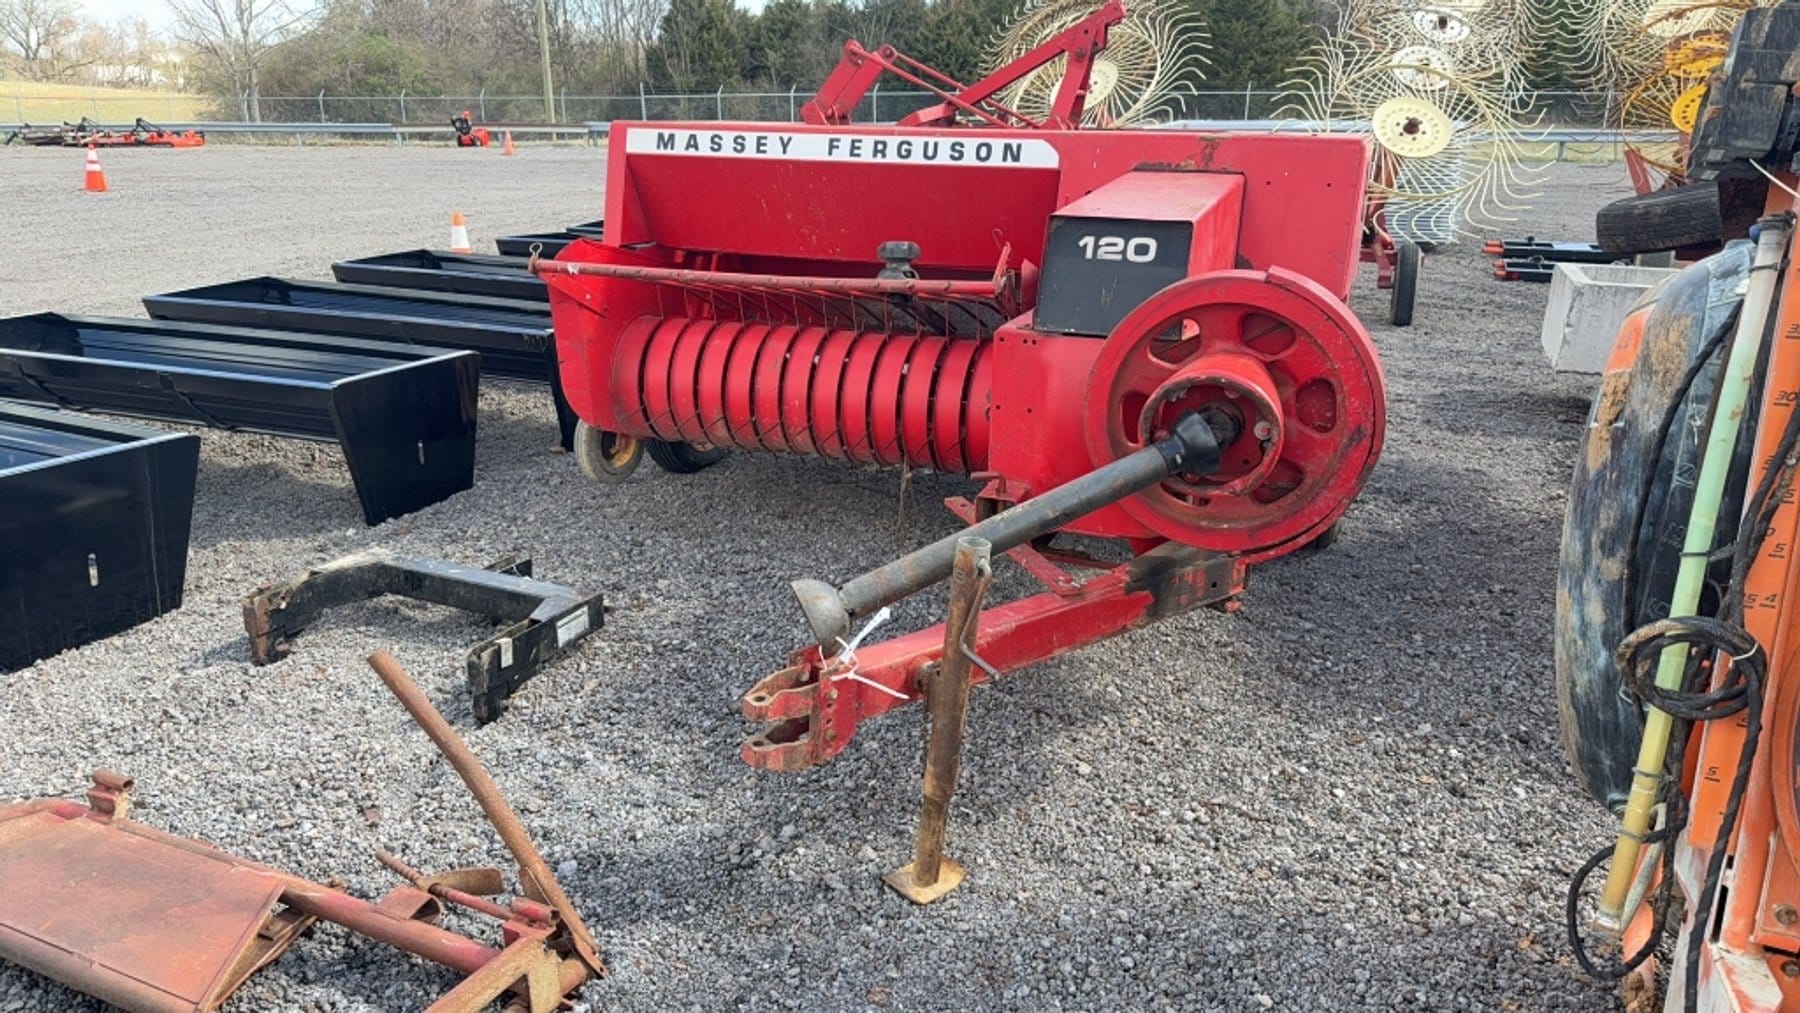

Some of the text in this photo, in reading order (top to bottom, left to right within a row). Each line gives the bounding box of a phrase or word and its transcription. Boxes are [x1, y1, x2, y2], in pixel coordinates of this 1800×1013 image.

[656, 132, 1022, 162] MASSEY FERGUSON
[1078, 236, 1157, 263] 120
[1775, 390, 1797, 402] 30
